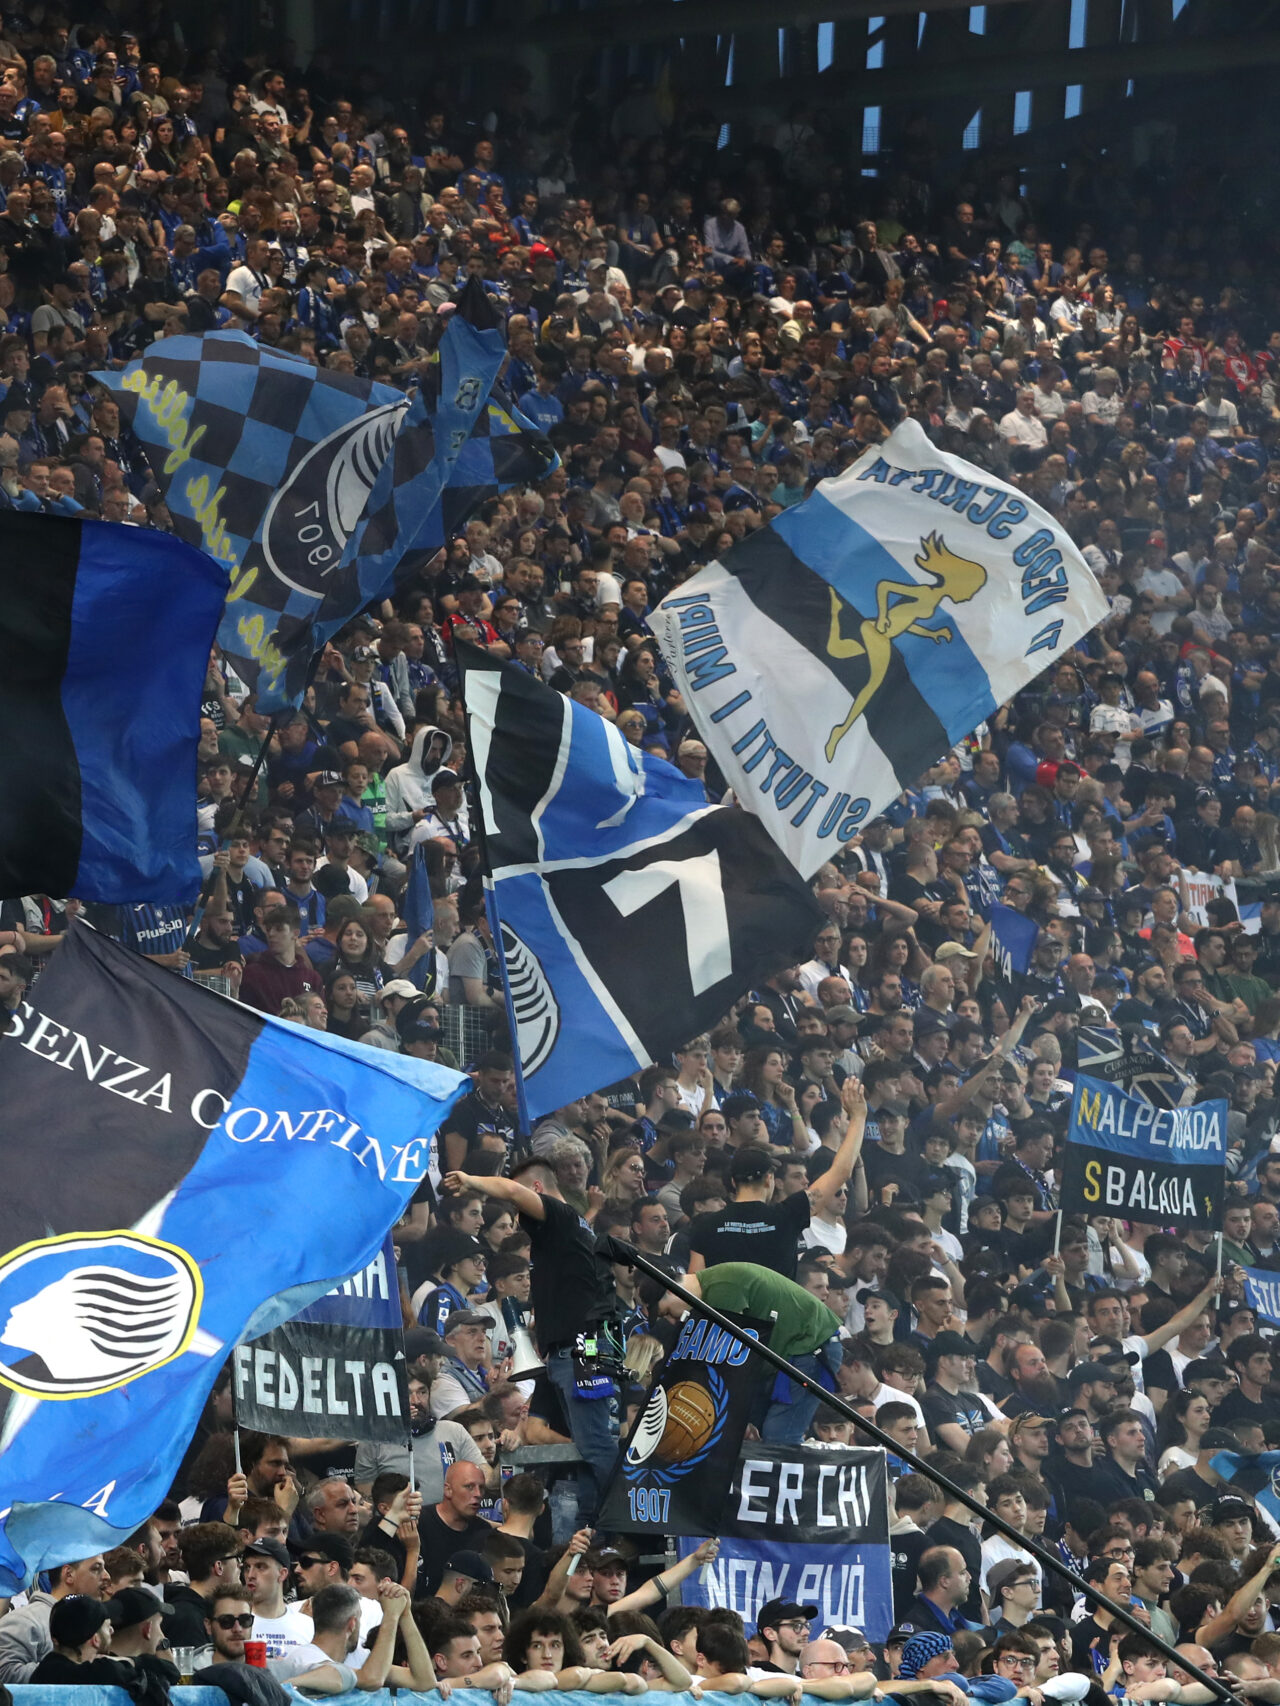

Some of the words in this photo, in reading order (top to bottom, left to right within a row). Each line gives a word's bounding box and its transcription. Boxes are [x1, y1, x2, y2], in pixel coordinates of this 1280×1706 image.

[3, 1000, 172, 1114] SENZA
[190, 1087, 428, 1183] CONFINE
[628, 1487, 671, 1523] 1907
[728, 1459, 804, 1526] ER
[816, 1464, 871, 1527] CHI
